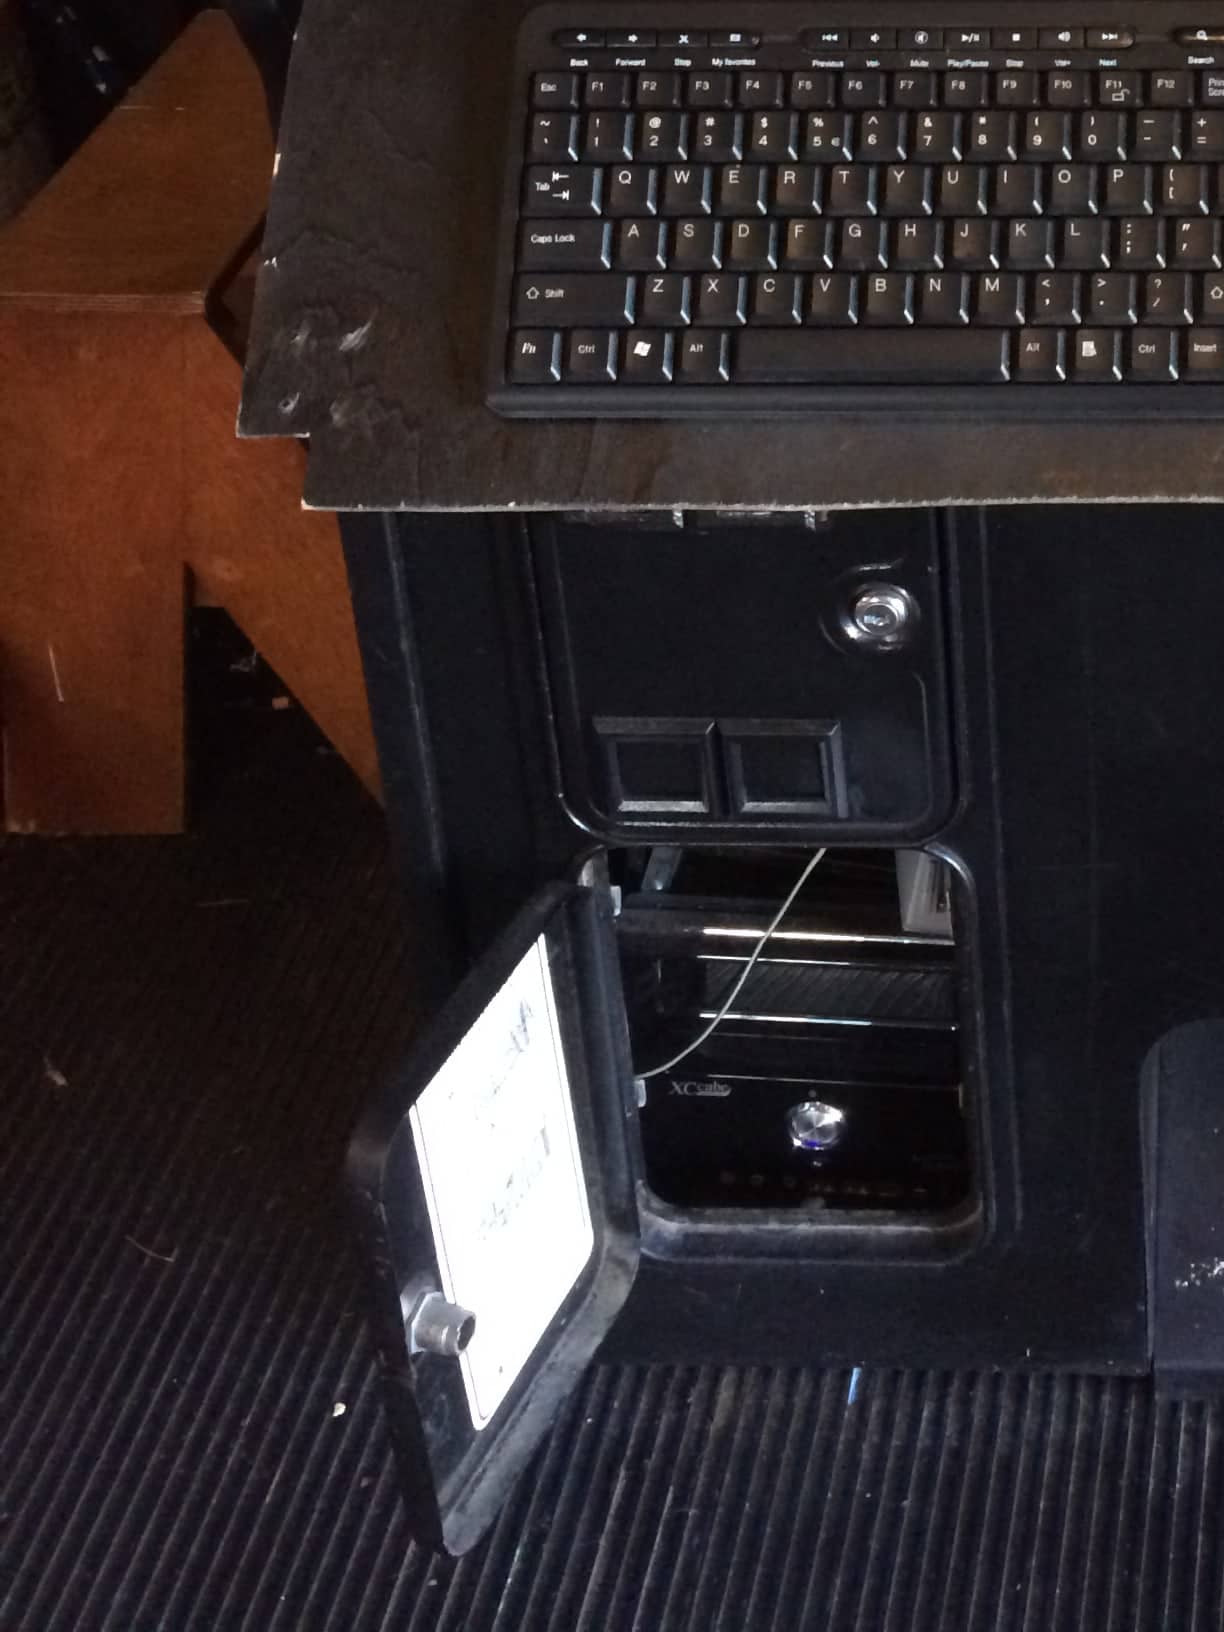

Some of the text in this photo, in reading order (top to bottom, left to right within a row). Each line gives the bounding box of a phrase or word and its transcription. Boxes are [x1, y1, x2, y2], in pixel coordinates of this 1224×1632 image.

[592, 82, 603, 92] F1
[642, 82, 657, 90] F2
[695, 82, 709, 90] F3
[746, 81, 759, 90] F4
[798, 81, 812, 90] F5
[848, 81, 862, 90] F6
[900, 81, 914, 89] F7
[951, 81, 965, 90] F8
[1003, 81, 1017, 89] F9
[1054, 81, 1072, 89] F10
[618, 171, 631, 184] Q
[674, 171, 690, 184] W
[729, 171, 739, 184] E
[784, 172, 795, 184] R
[836, 171, 849, 184] T
[893, 169, 904, 183] Y
[947, 171, 958, 184] U
[1058, 170, 1071, 183] O
[1113, 170, 1124, 183] P
[627, 225, 639, 237] A
[683, 225, 694, 237] S
[738, 224, 749, 237] D
[794, 224, 804, 237] F
[849, 224, 861, 237] G
[905, 225, 916, 237] H
[960, 225, 968, 237] J
[1016, 224, 1026, 236] K
[1070, 224, 1080, 236] L
[531, 234, 575, 244] Caps Lock
[652, 279, 664, 293] Z
[707, 280, 718, 292] X
[763, 279, 775, 292] C
[820, 279, 830, 292] V
[875, 279, 887, 292] B
[929, 279, 941, 292] N
[985, 278, 999, 292] M
